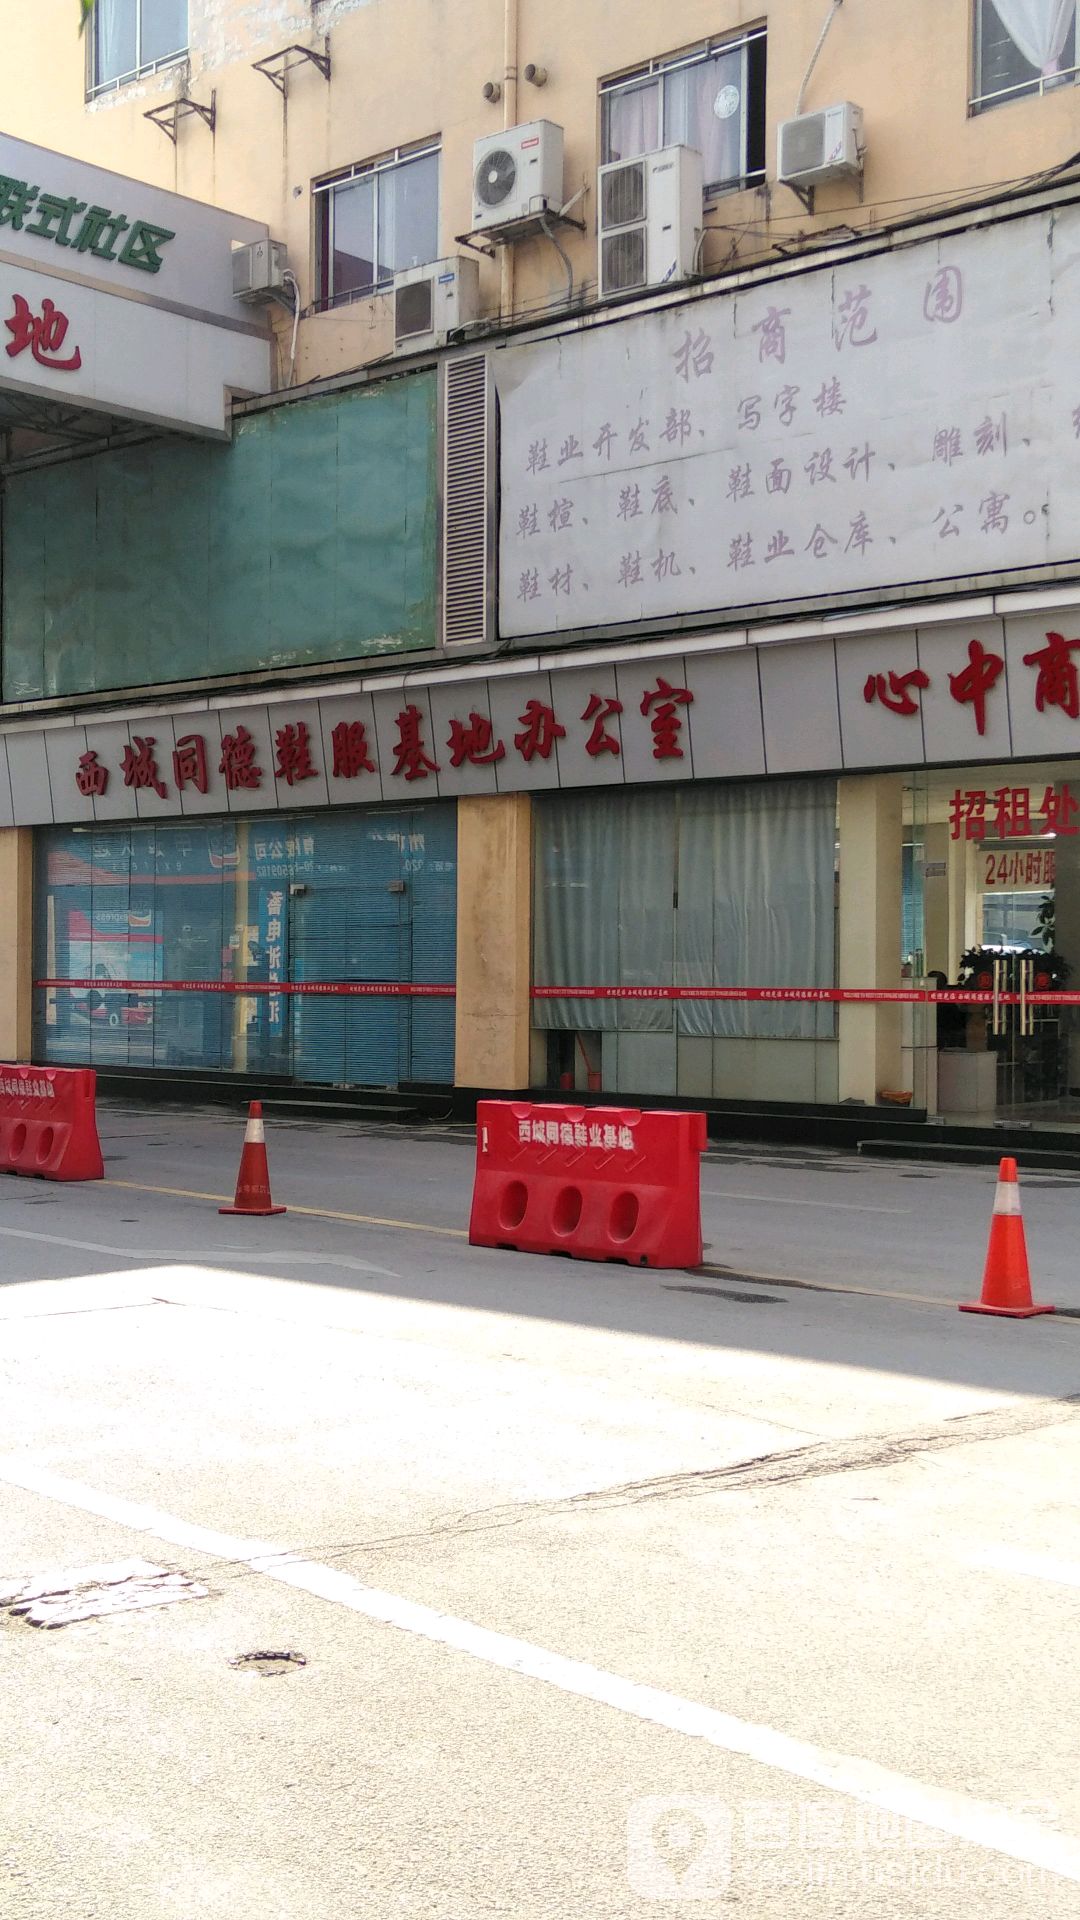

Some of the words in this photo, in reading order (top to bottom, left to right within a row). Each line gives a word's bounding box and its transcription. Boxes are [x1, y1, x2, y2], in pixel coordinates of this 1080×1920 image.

[5, 294, 82, 370] 地
[673, 266, 963, 383] 招商范围
[75, 678, 692, 799] 西城同德鞋服基地办公室
[949, 784, 1080, 840] 招租处
